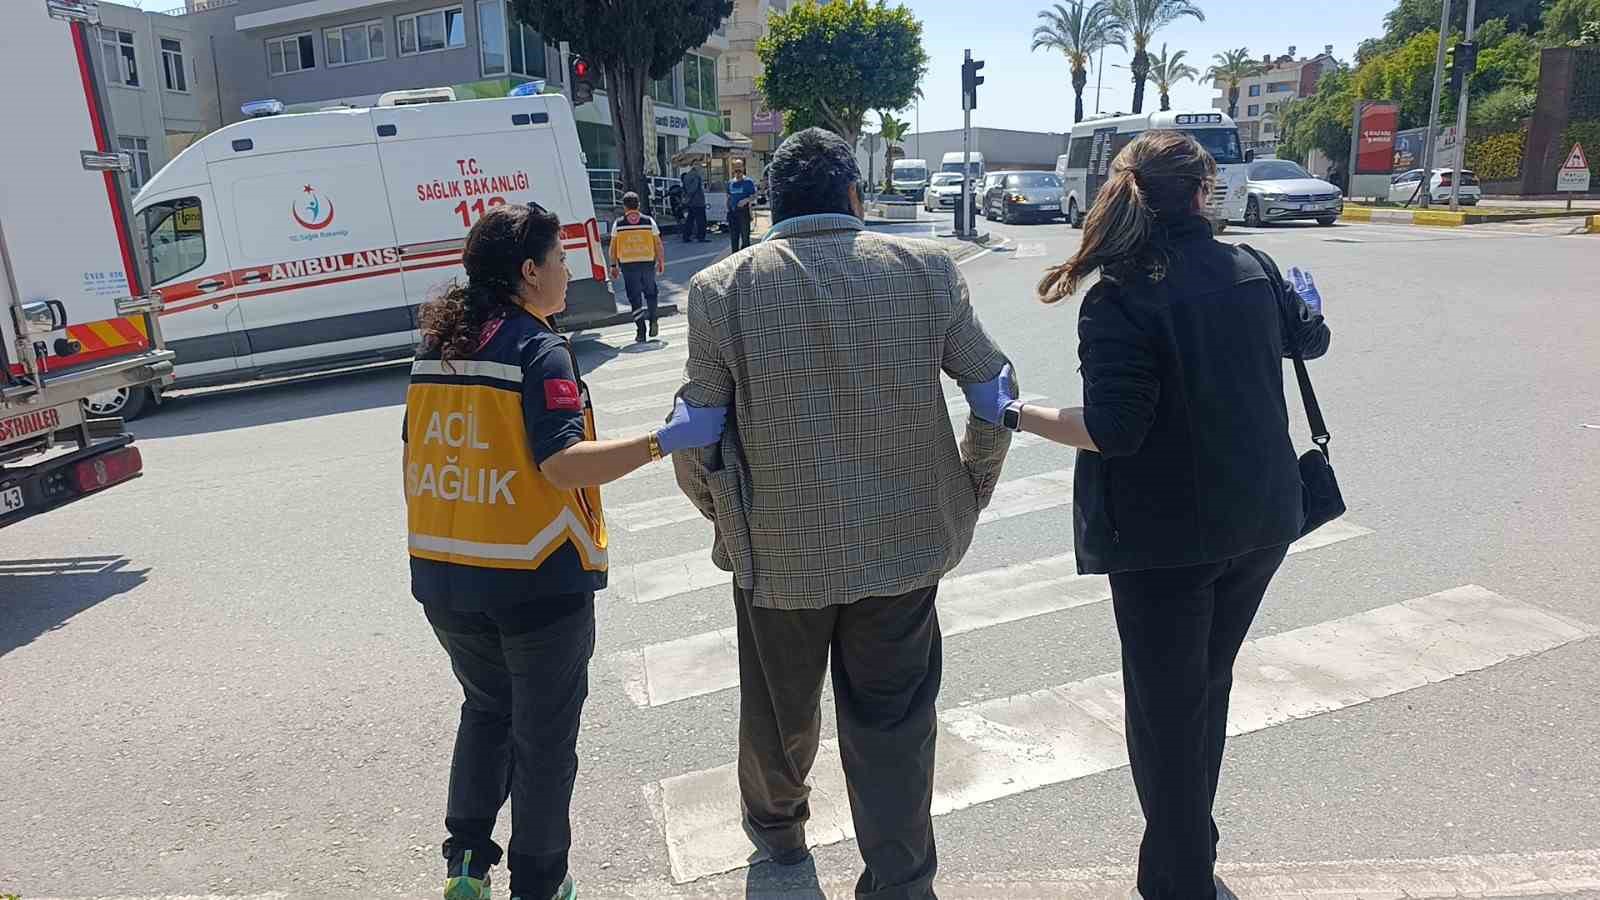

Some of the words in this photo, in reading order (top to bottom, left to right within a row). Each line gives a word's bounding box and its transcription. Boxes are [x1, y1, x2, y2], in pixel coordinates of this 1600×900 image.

[1176, 114, 1221, 124] SIDE
[456, 159, 482, 176] T.C.
[417, 179, 462, 202] SAĞLIK
[464, 170, 530, 196] BAKANLIĞI
[270, 247, 397, 281] AMBULANS
[423, 403, 489, 450] ACİL
[407, 456, 519, 505] SAĞLIK
[4, 489, 21, 510] 43
